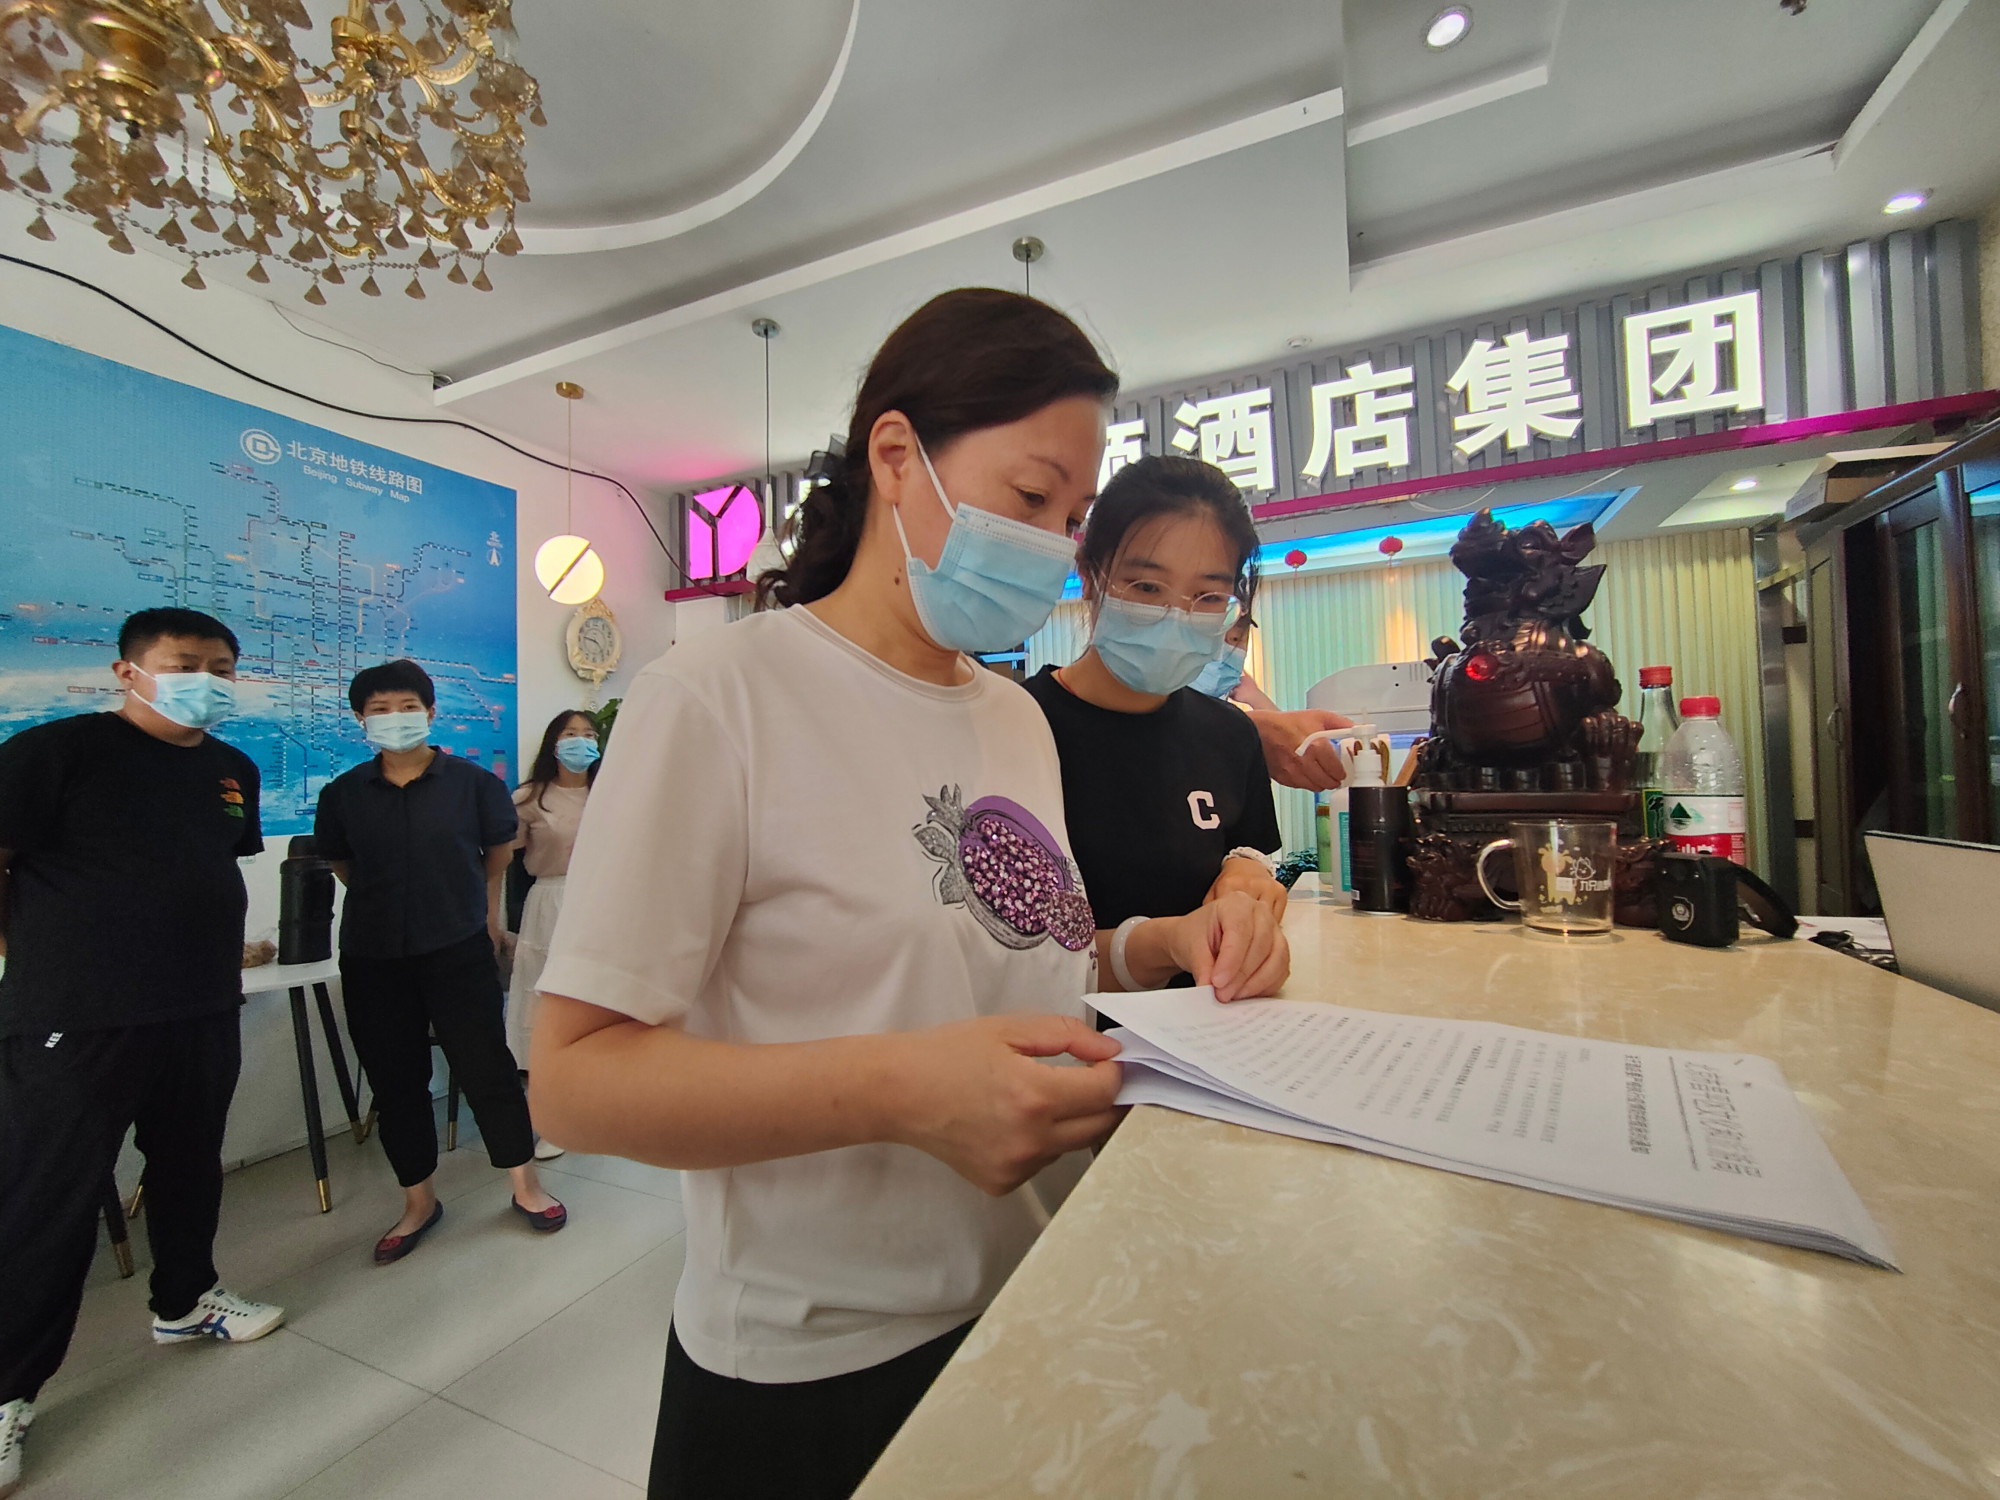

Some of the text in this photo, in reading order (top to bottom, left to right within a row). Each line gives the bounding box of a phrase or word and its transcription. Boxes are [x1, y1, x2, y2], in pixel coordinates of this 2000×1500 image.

[286, 440, 422, 494] 北京地铁线路图
[303, 465, 410, 503] Beijing Subway Map
[1187, 790, 1221, 830] C
